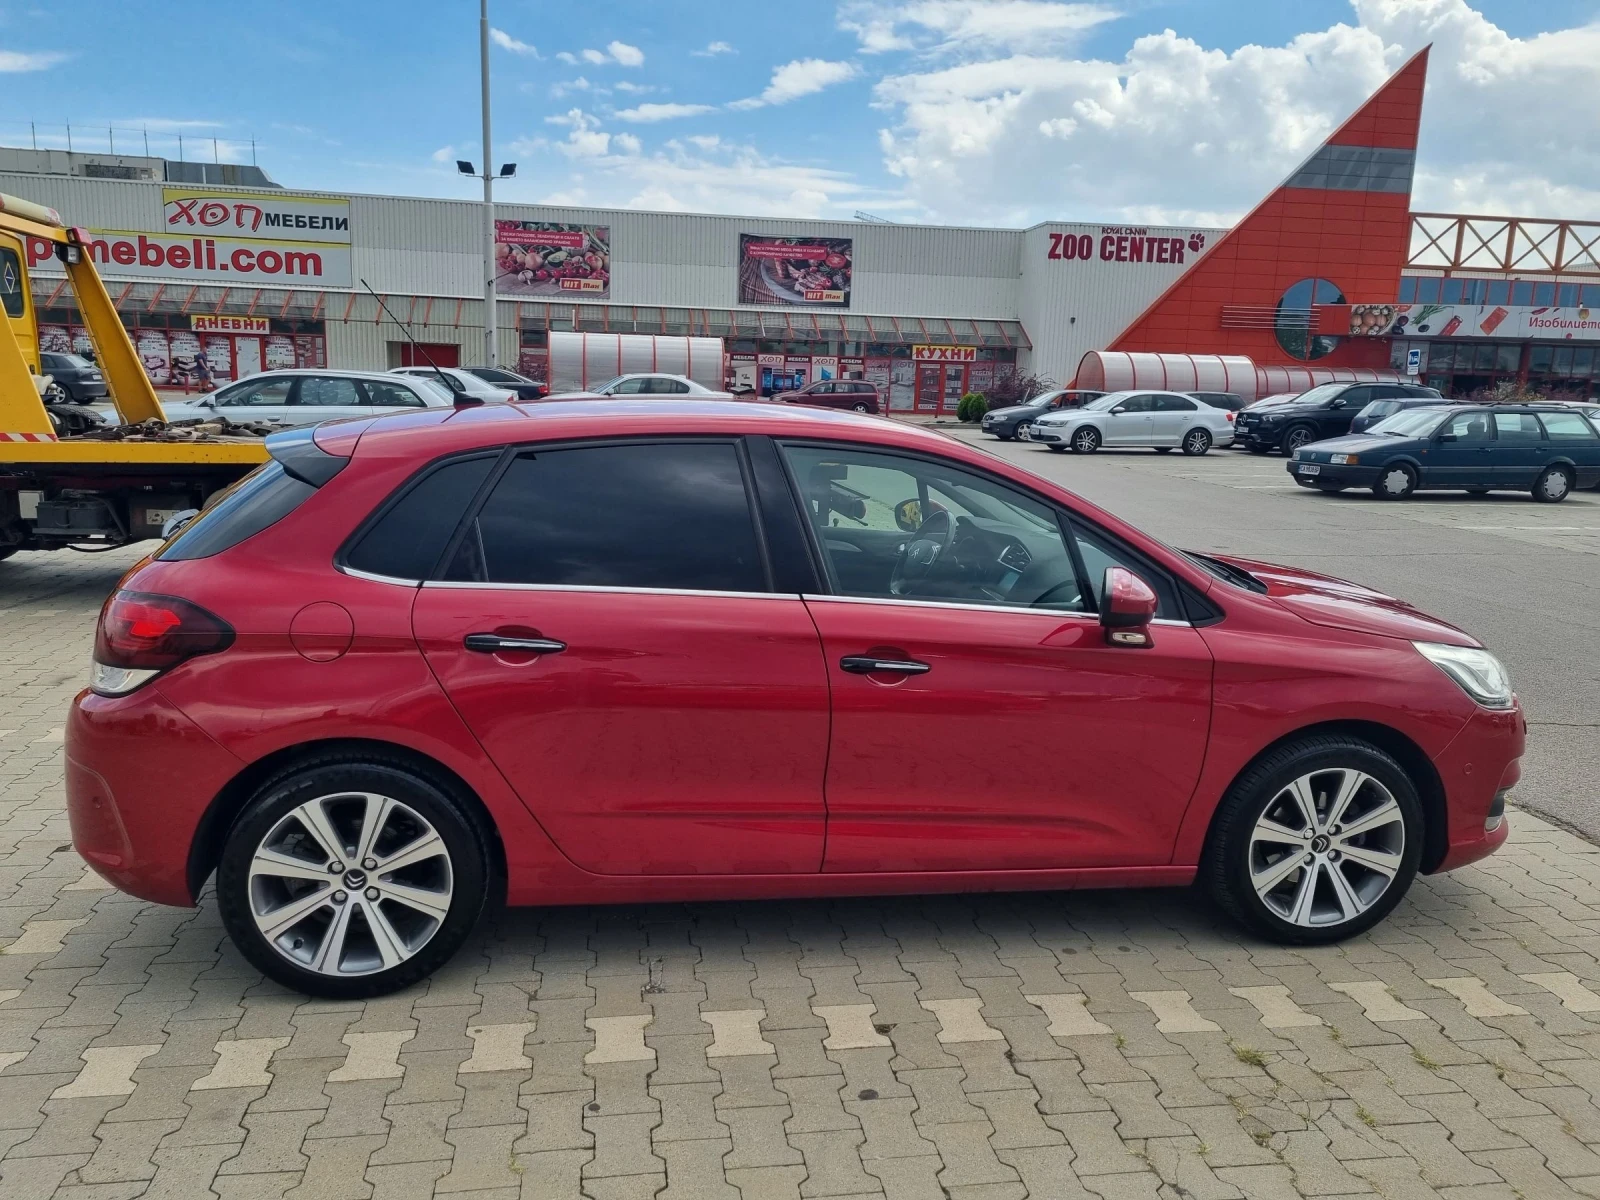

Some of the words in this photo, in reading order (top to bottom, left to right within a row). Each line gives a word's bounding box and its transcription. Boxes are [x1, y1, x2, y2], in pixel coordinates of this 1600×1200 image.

[169, 199, 263, 232] ХОП
[265, 213, 349, 231] МЕБЕЛИ
[1048, 233, 1092, 260] ZOO
[1100, 235, 1185, 264] CENTER
[563, 280, 579, 289] HIT
[807, 292, 822, 300] HIT
[195, 317, 268, 332] ДНЕВНИ
[915, 347, 975, 360] КУХНИ
